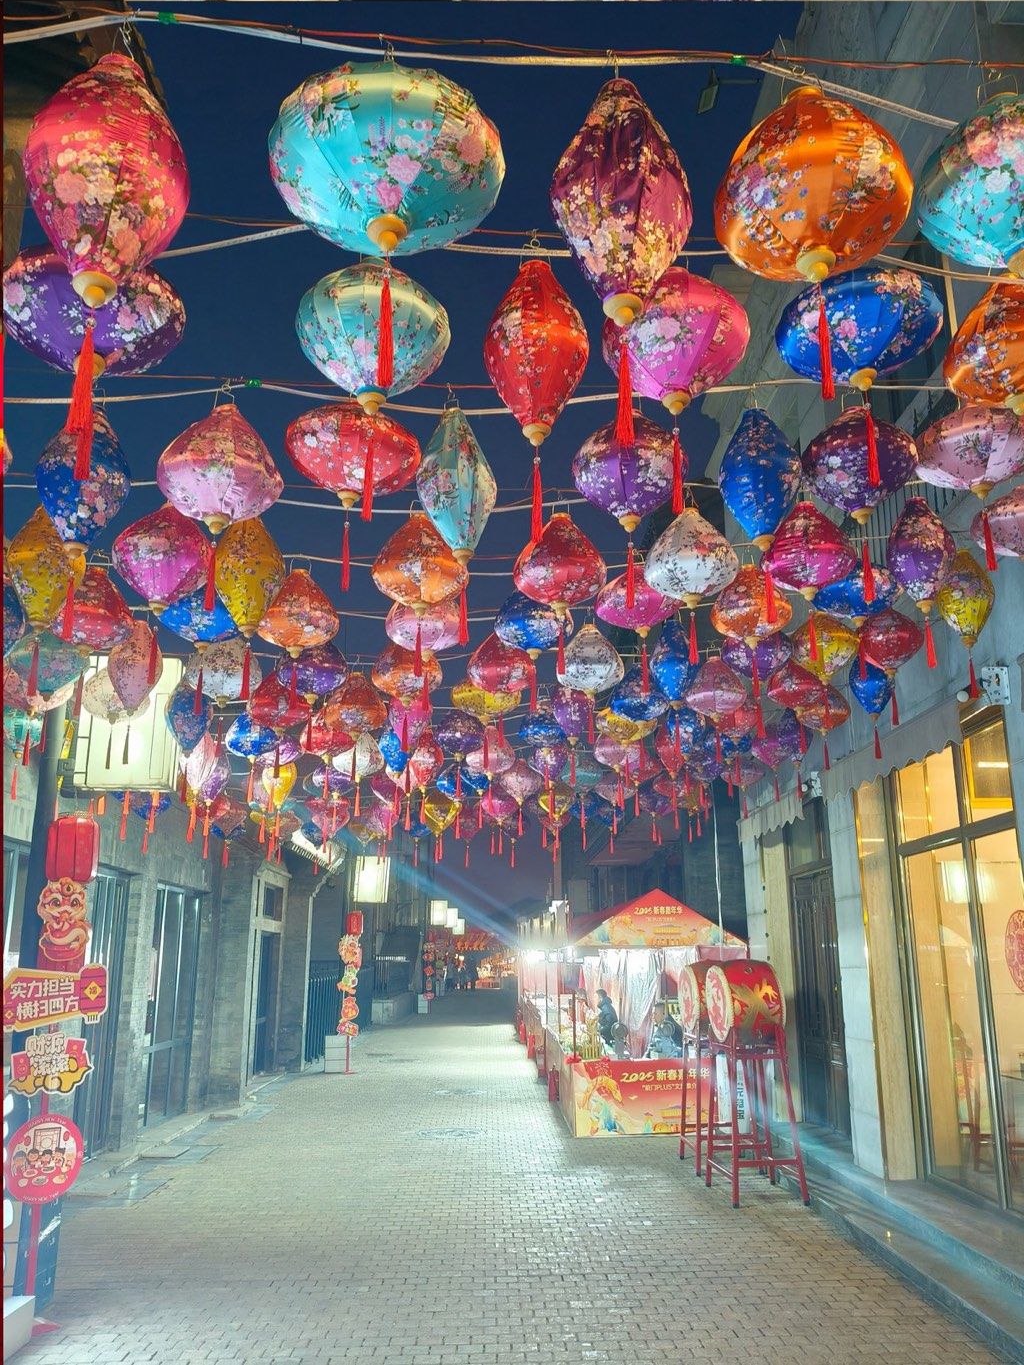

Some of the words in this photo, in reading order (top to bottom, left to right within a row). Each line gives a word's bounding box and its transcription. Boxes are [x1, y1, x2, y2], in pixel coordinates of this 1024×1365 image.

[10, 977, 74, 999] 实力担当
[16, 995, 80, 1021] 横扫四方
[27, 1033, 66, 1056] 财源
